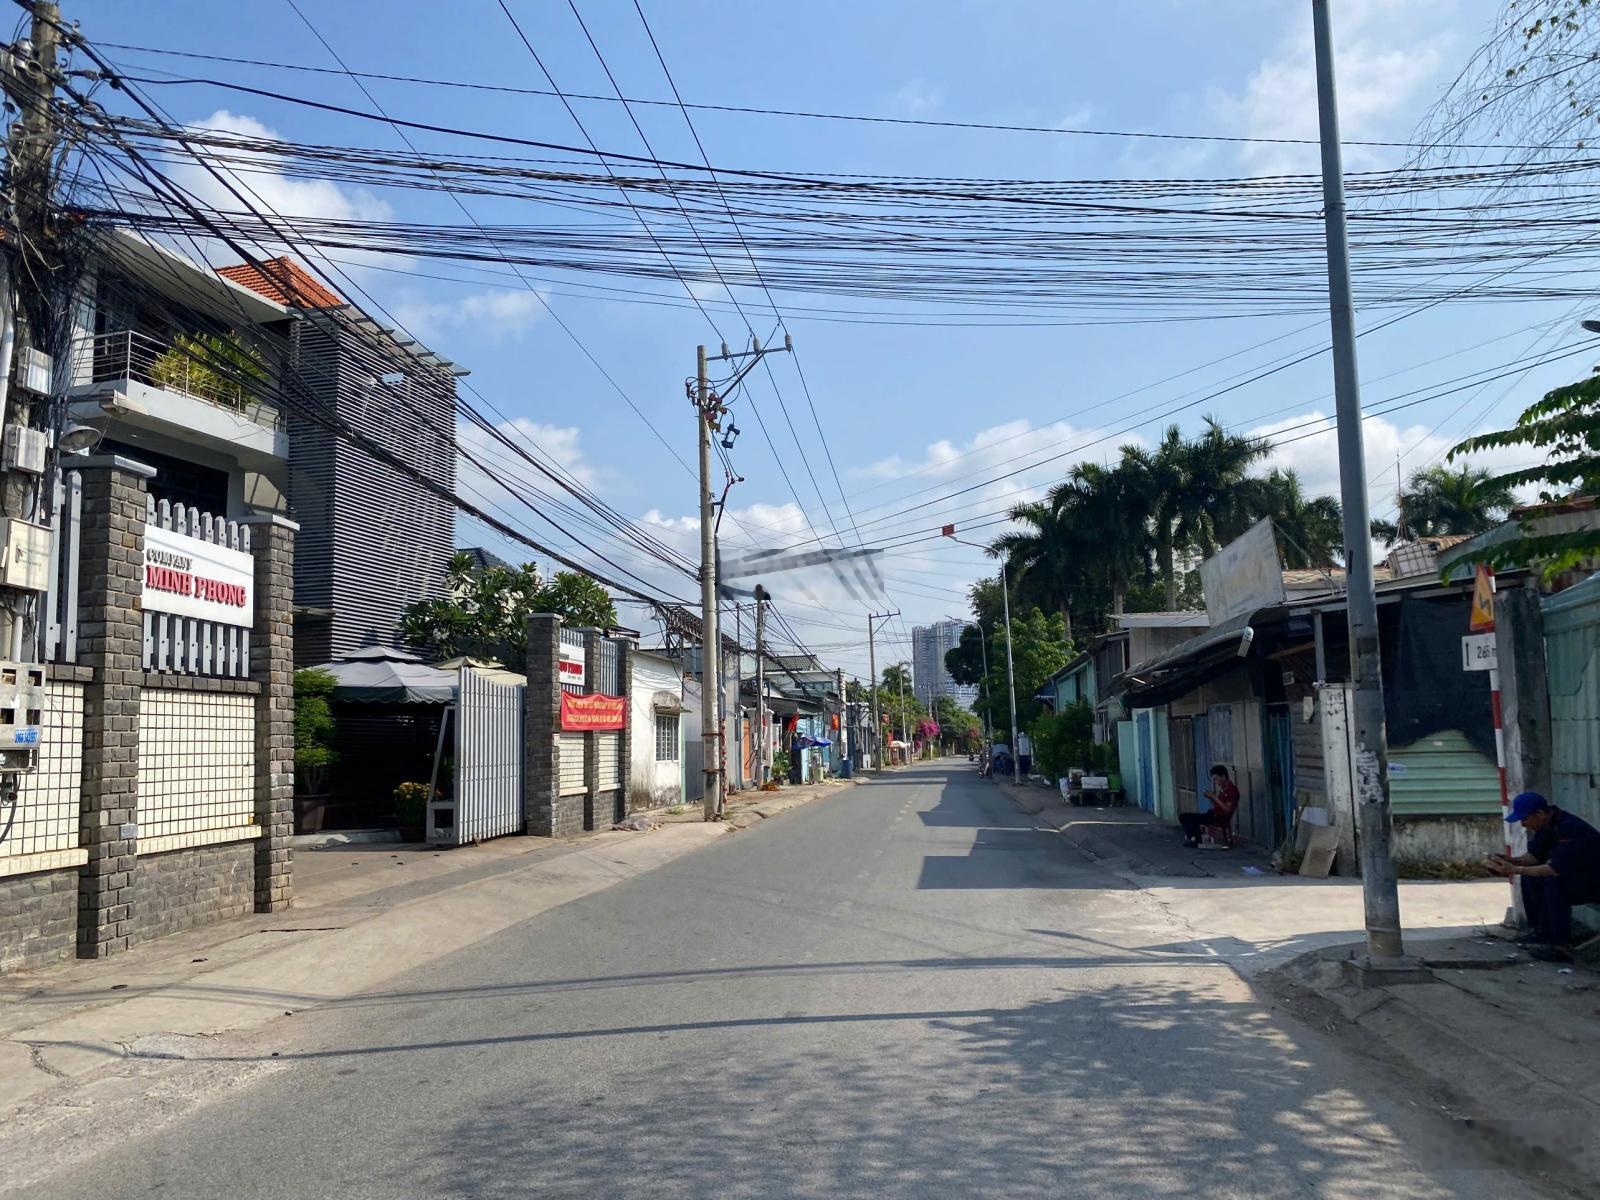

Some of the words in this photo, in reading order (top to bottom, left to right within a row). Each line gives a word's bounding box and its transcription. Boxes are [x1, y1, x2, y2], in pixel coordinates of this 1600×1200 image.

[146, 548, 193, 570] COMPANY
[146, 565, 192, 596] MINH
[194, 576, 247, 608] PHONG
